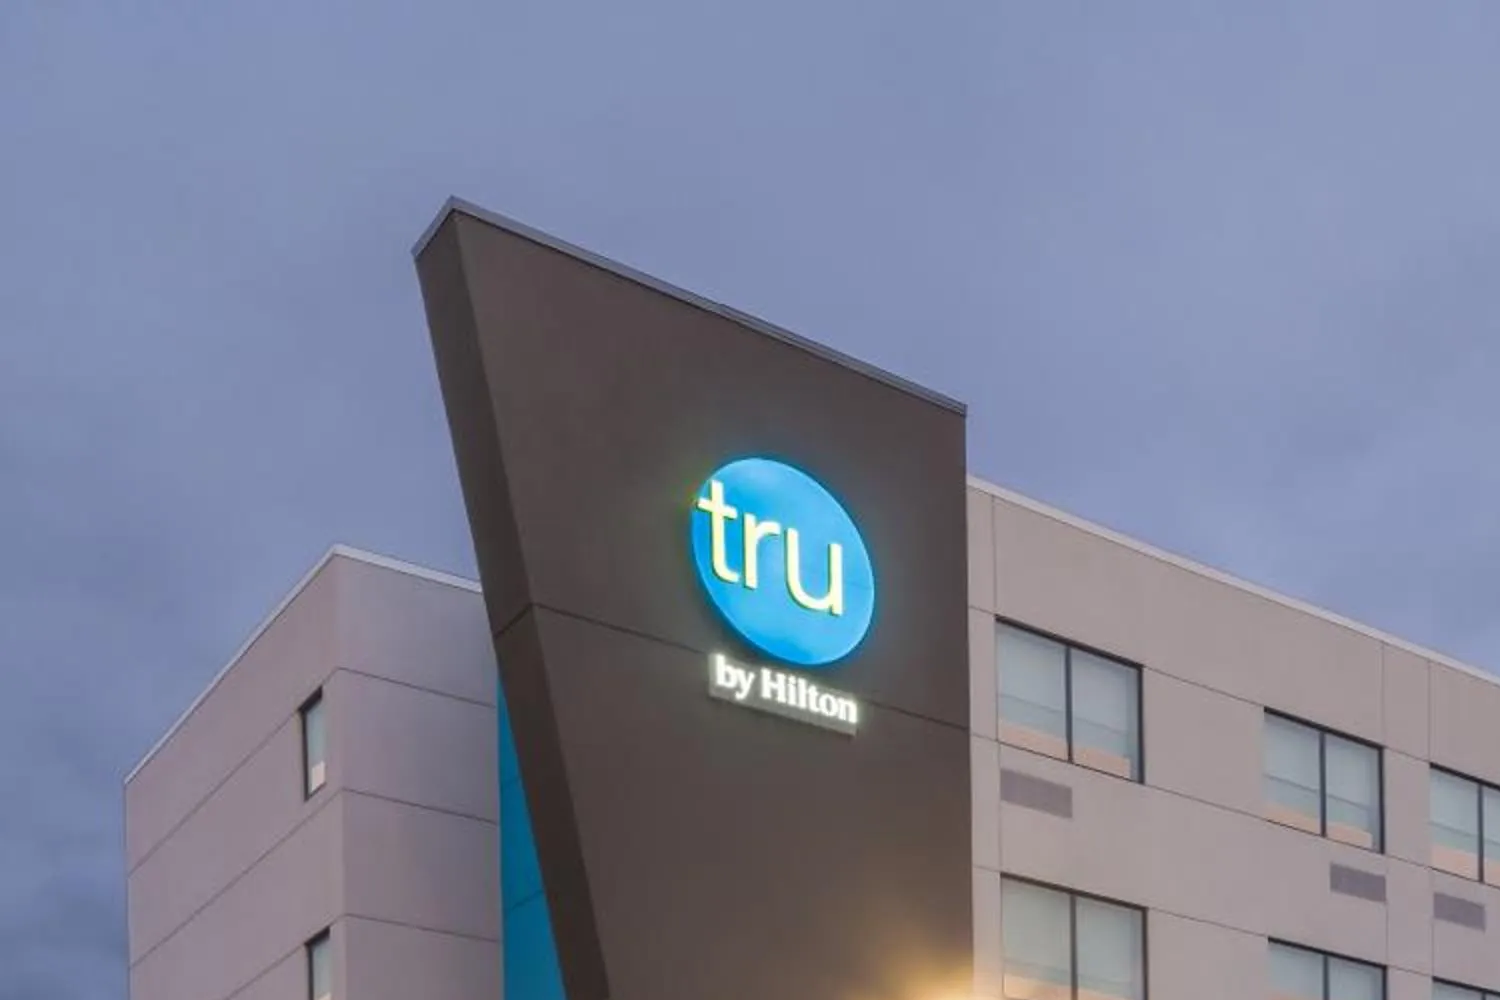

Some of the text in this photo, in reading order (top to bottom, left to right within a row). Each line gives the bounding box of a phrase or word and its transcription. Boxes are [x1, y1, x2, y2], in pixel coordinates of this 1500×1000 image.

[697, 479, 843, 616] tru
[714, 654, 857, 723] by Hilton
